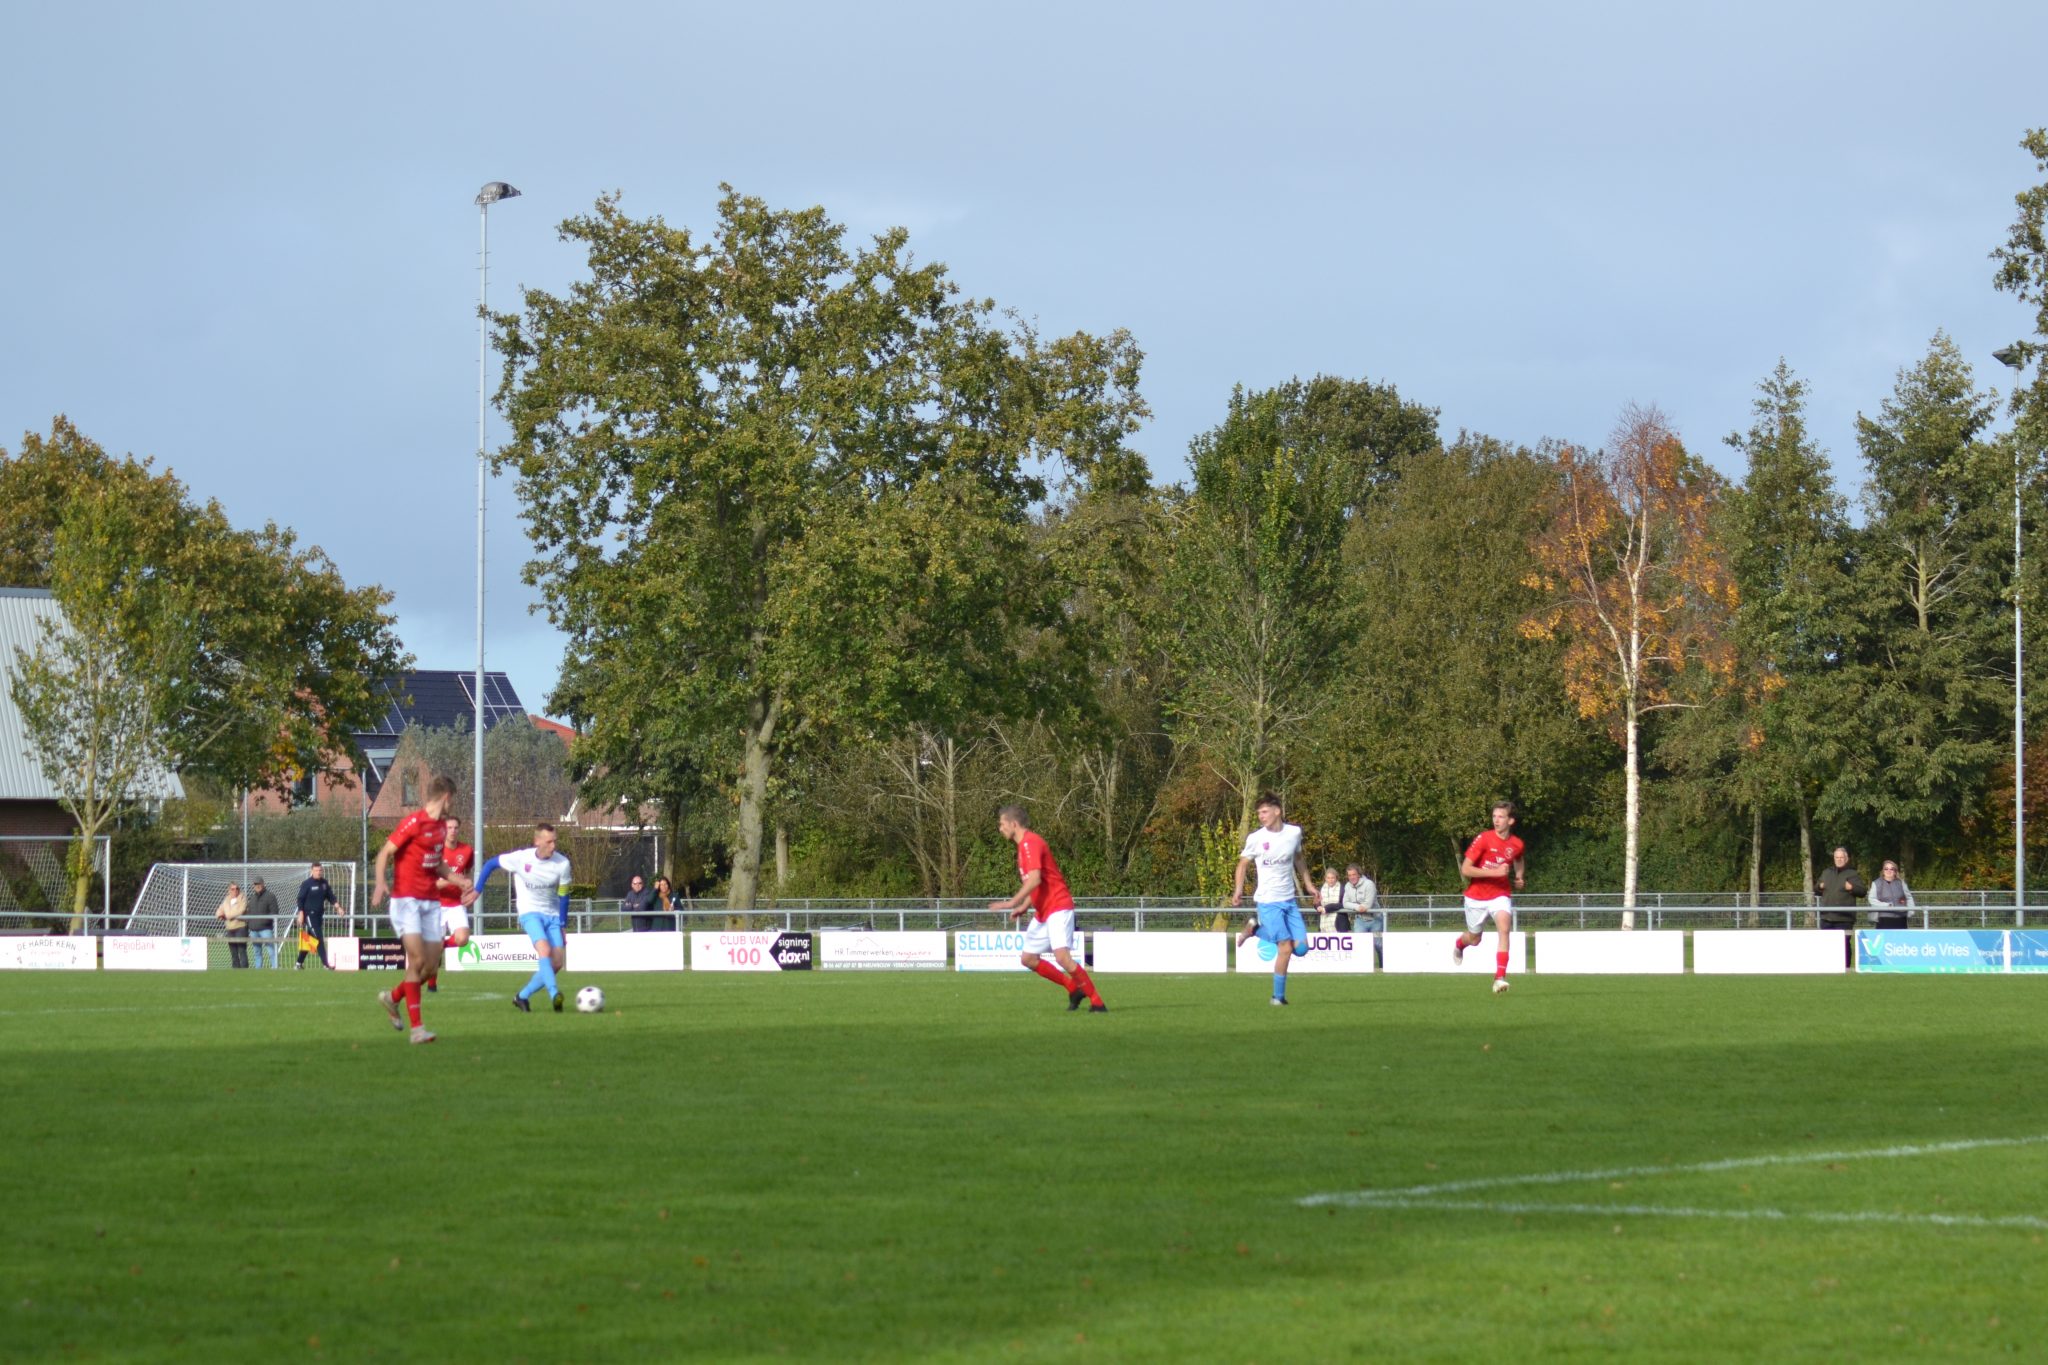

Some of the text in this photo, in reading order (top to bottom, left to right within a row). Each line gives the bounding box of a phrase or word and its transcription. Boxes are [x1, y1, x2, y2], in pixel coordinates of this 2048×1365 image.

[17, 939, 77, 952] DE HARDE KERN
[112, 938, 155, 953] RegioBank
[480, 942, 501, 950] VISIT
[719, 935, 769, 945] CLUB VAN
[1308, 936, 1353, 951] JONG
[727, 947, 761, 965] 100
[1884, 942, 1969, 957] Siebe de Vries
